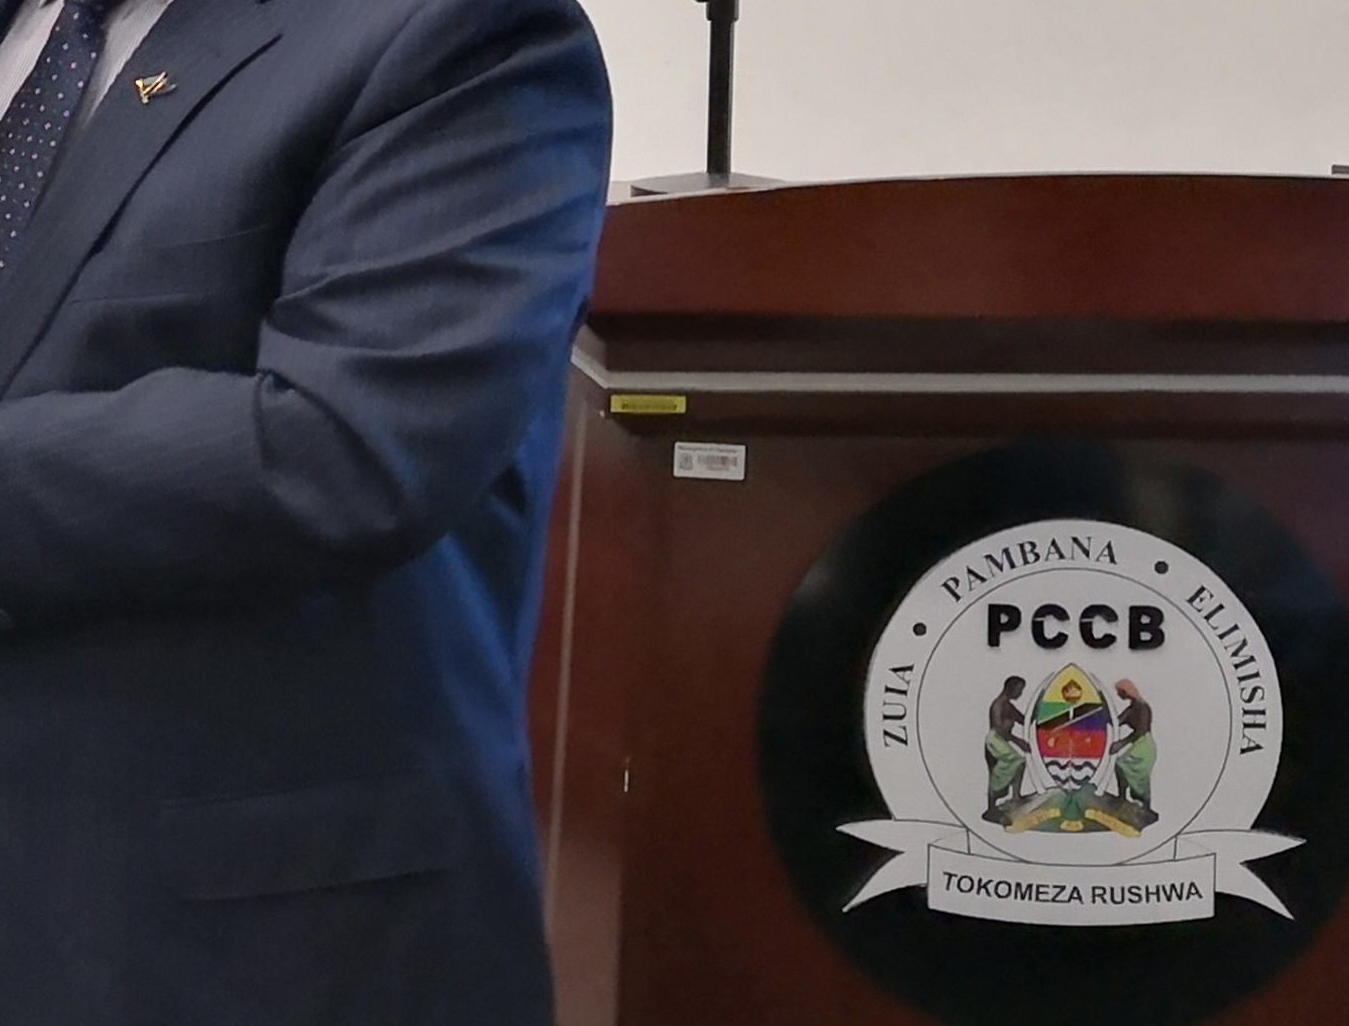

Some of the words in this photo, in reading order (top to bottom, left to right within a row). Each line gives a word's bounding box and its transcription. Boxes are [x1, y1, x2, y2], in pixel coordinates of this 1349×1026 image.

[882, 663, 915, 748] ZUIA
[940, 535, 1119, 603] PAMBANA
[1184, 584, 1268, 756] ELIMISHA
[987, 603, 1166, 651] PCCB
[942, 871, 1084, 905] TOKOMEZA
[1091, 881, 1204, 905] RUSHWA
